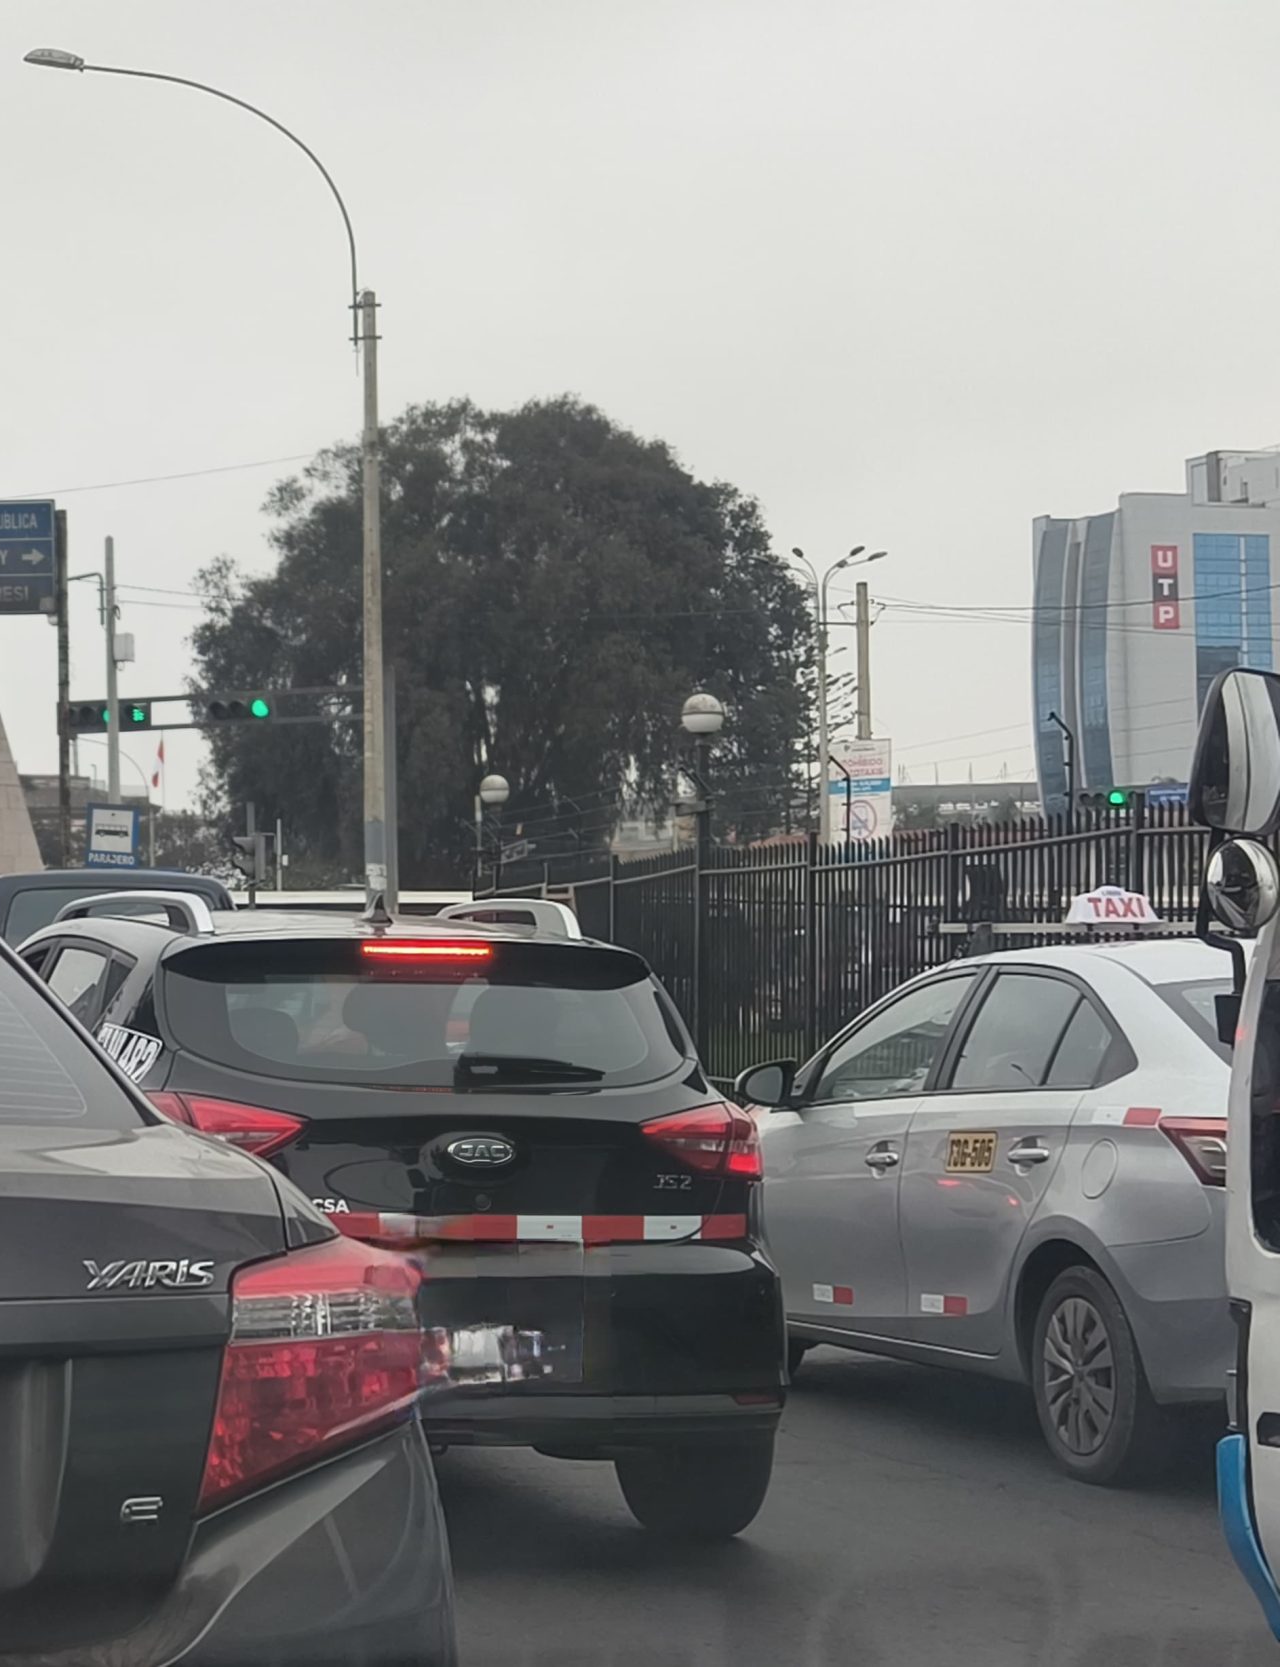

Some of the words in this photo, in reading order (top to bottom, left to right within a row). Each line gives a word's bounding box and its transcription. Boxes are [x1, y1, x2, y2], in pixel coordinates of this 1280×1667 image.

[1157, 551, 1175, 624] UTP
[1087, 896, 1146, 918] TAXI
[83, 1259, 216, 1291] YARIS
